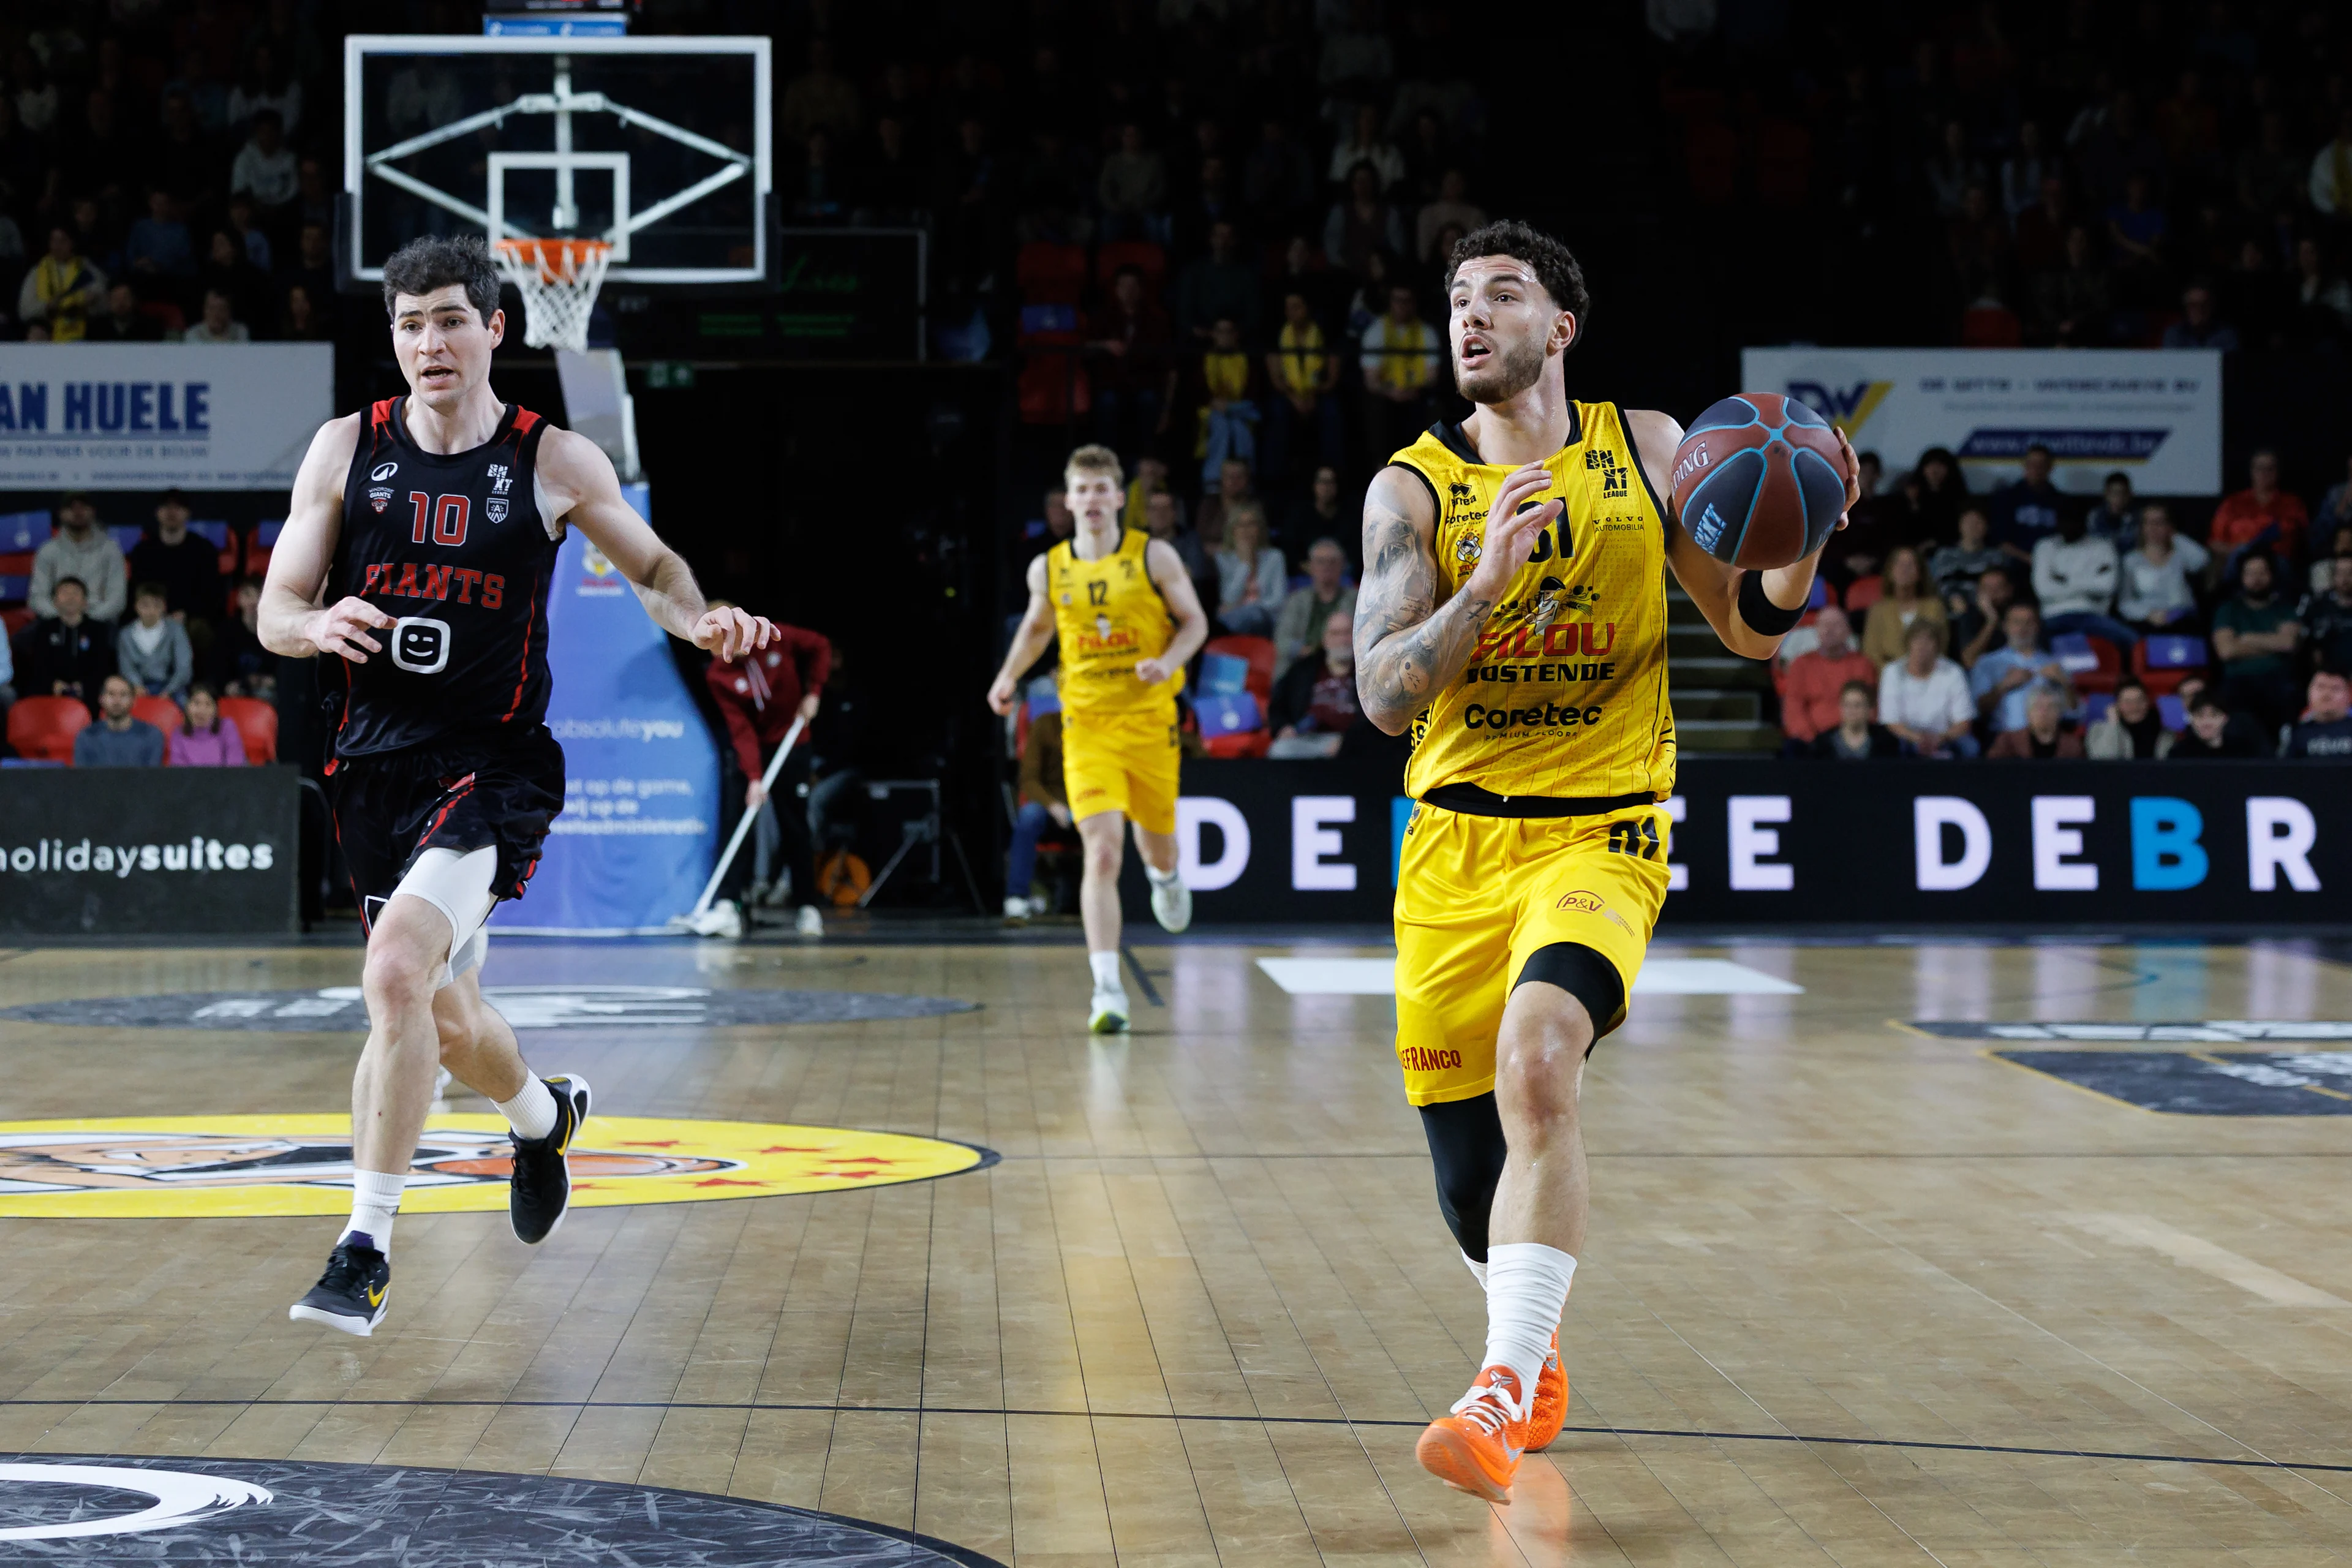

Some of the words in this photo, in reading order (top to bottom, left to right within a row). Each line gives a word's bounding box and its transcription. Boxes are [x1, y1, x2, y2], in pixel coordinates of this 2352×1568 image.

[63, 382, 211, 431] HUELE
[1672, 440, 1712, 497] DING
[1603, 490, 1628, 499] LEAGUE
[409, 491, 471, 546] 10
[1592, 516, 1643, 525] VOLVO
[1594, 524, 1644, 534] AUTOMOBILIA
[360, 562, 506, 610] GIANTS
[1087, 579, 1109, 606] 12
[1470, 622, 1615, 664] FILOU
[1466, 662, 1616, 684] OOSTENDE
[1464, 703, 1603, 729] Coretec
[1562, 897, 1604, 912] P&V
[1401, 1046, 1462, 1072] EFRANCQ
